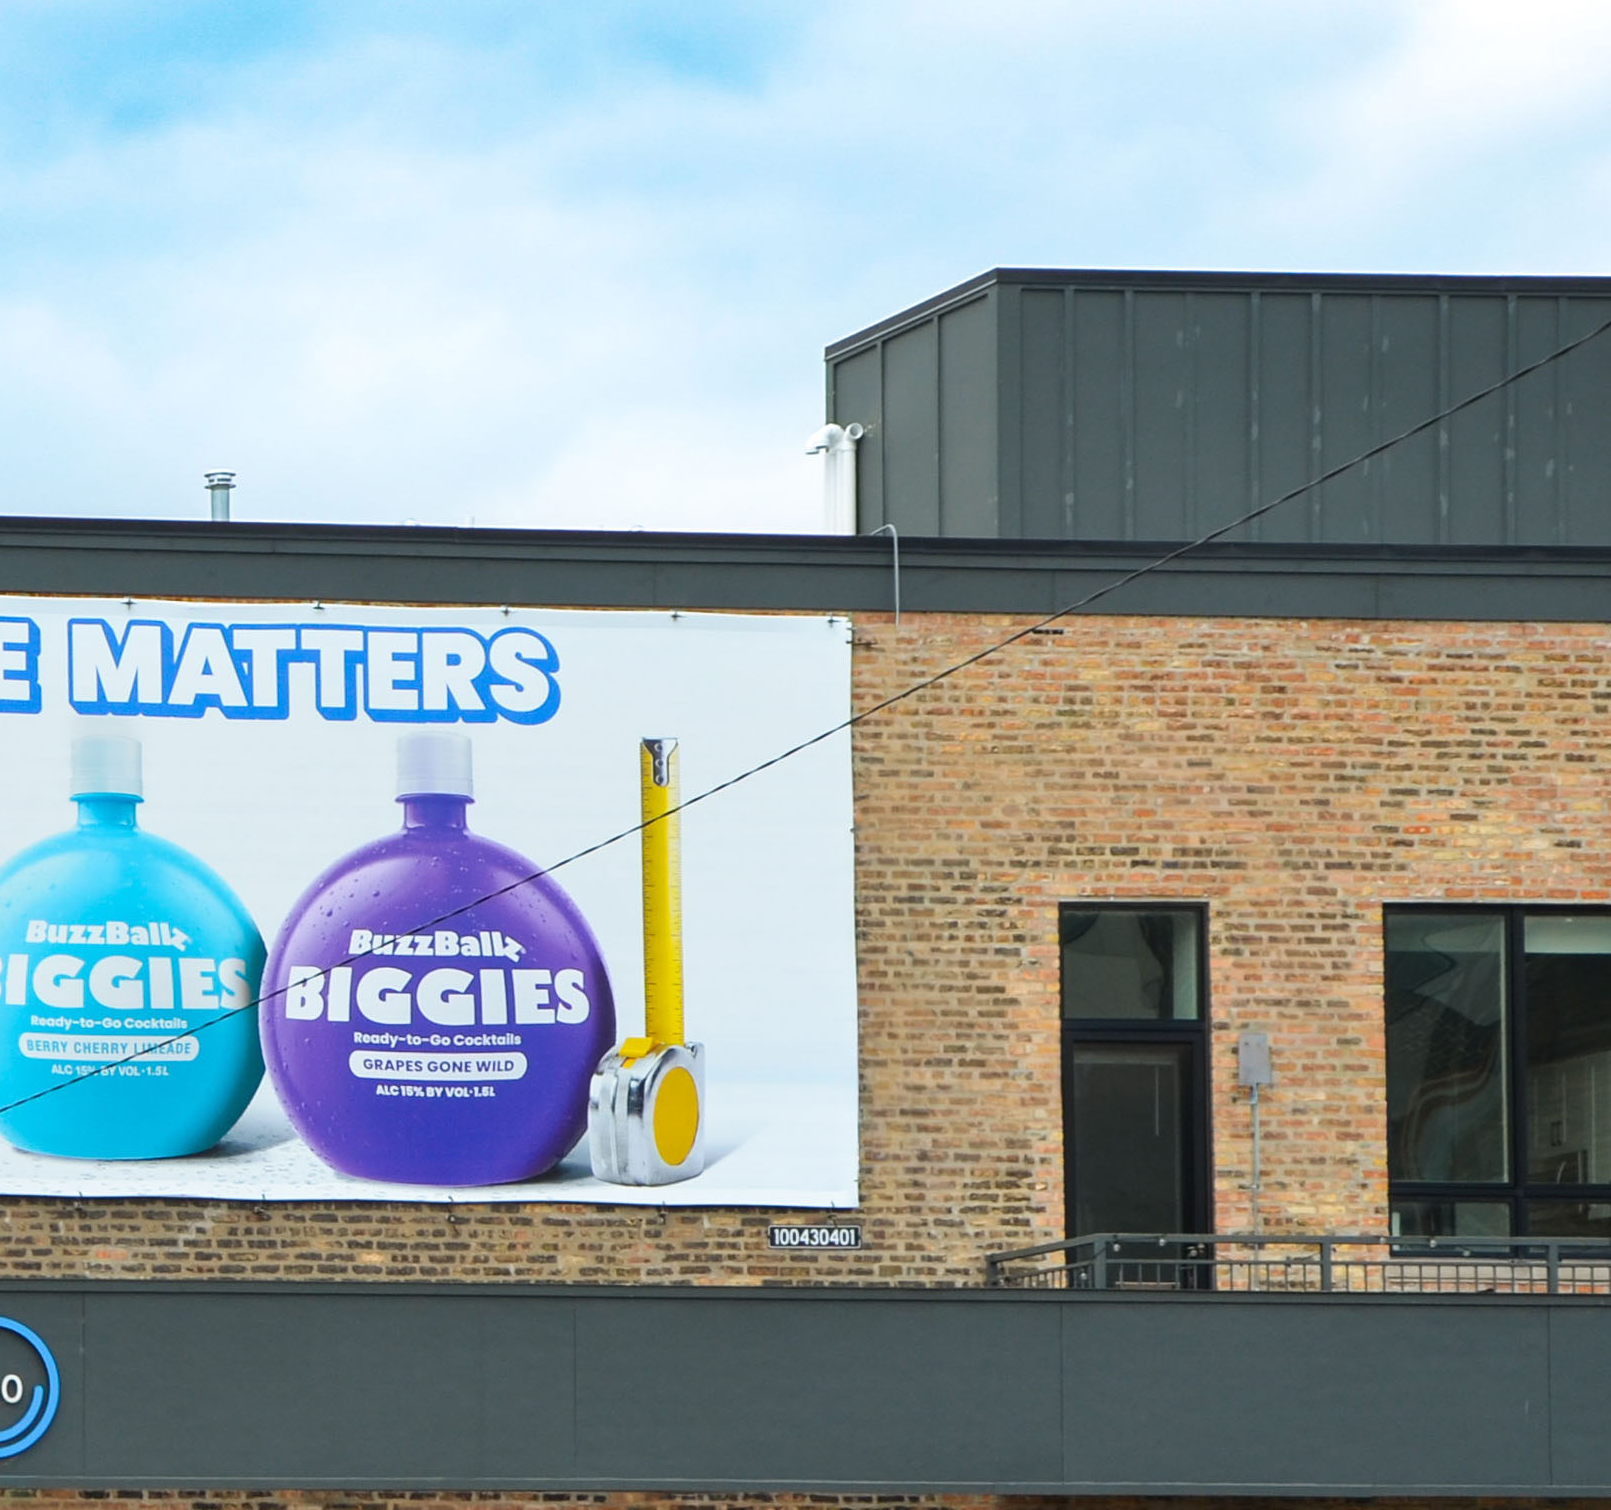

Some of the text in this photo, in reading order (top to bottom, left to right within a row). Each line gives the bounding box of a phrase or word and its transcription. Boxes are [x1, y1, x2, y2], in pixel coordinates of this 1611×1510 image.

[68, 618, 560, 725] MATTERS
[26, 920, 190, 951] BuzzBallz
[348, 929, 526, 963] BuzzBallz
[286, 965, 590, 1026] BIGGIES
[30, 1015, 187, 1030] Ready-to-Go Cocktails
[27, 1039, 192, 1055] BERRY CHERRY LIMEADE
[354, 1031, 521, 1047] Ready-to-Go Cocktails
[51, 1064, 73, 1074] ALC
[75, 1065, 98, 1076] 15%
[363, 1058, 514, 1073] GRAPES GONE WILD
[376, 1084, 400, 1096] ALC
[401, 1085, 424, 1097] 15%
[426, 1086, 444, 1097] BY
[774, 1228, 856, 1246] 100430401
